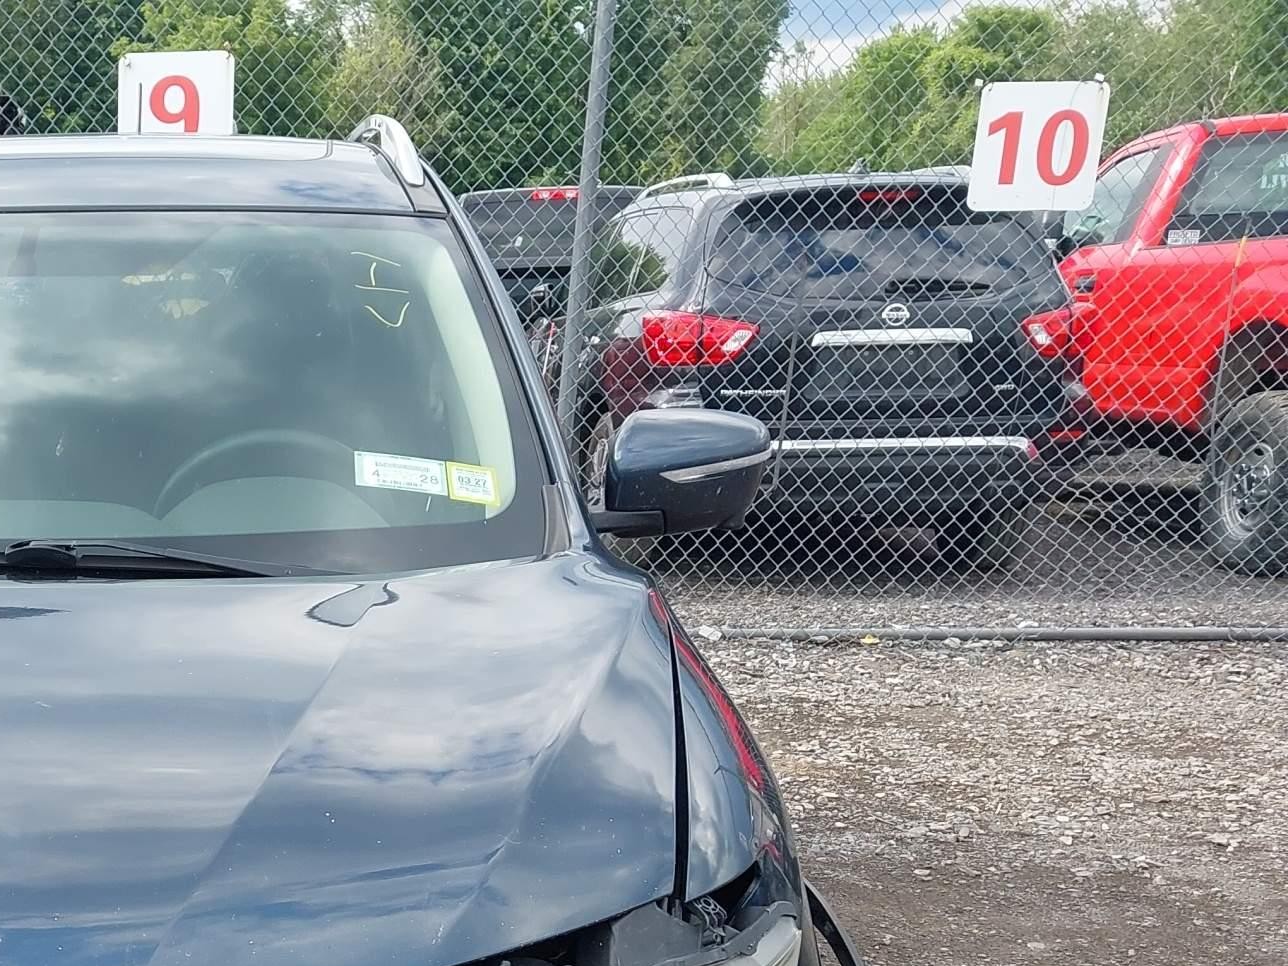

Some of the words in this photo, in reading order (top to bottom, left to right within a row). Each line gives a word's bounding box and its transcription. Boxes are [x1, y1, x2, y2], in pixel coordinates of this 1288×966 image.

[150, 75, 200, 134] 9
[987, 109, 1090, 187] 10
[419, 474, 440, 485] 28
